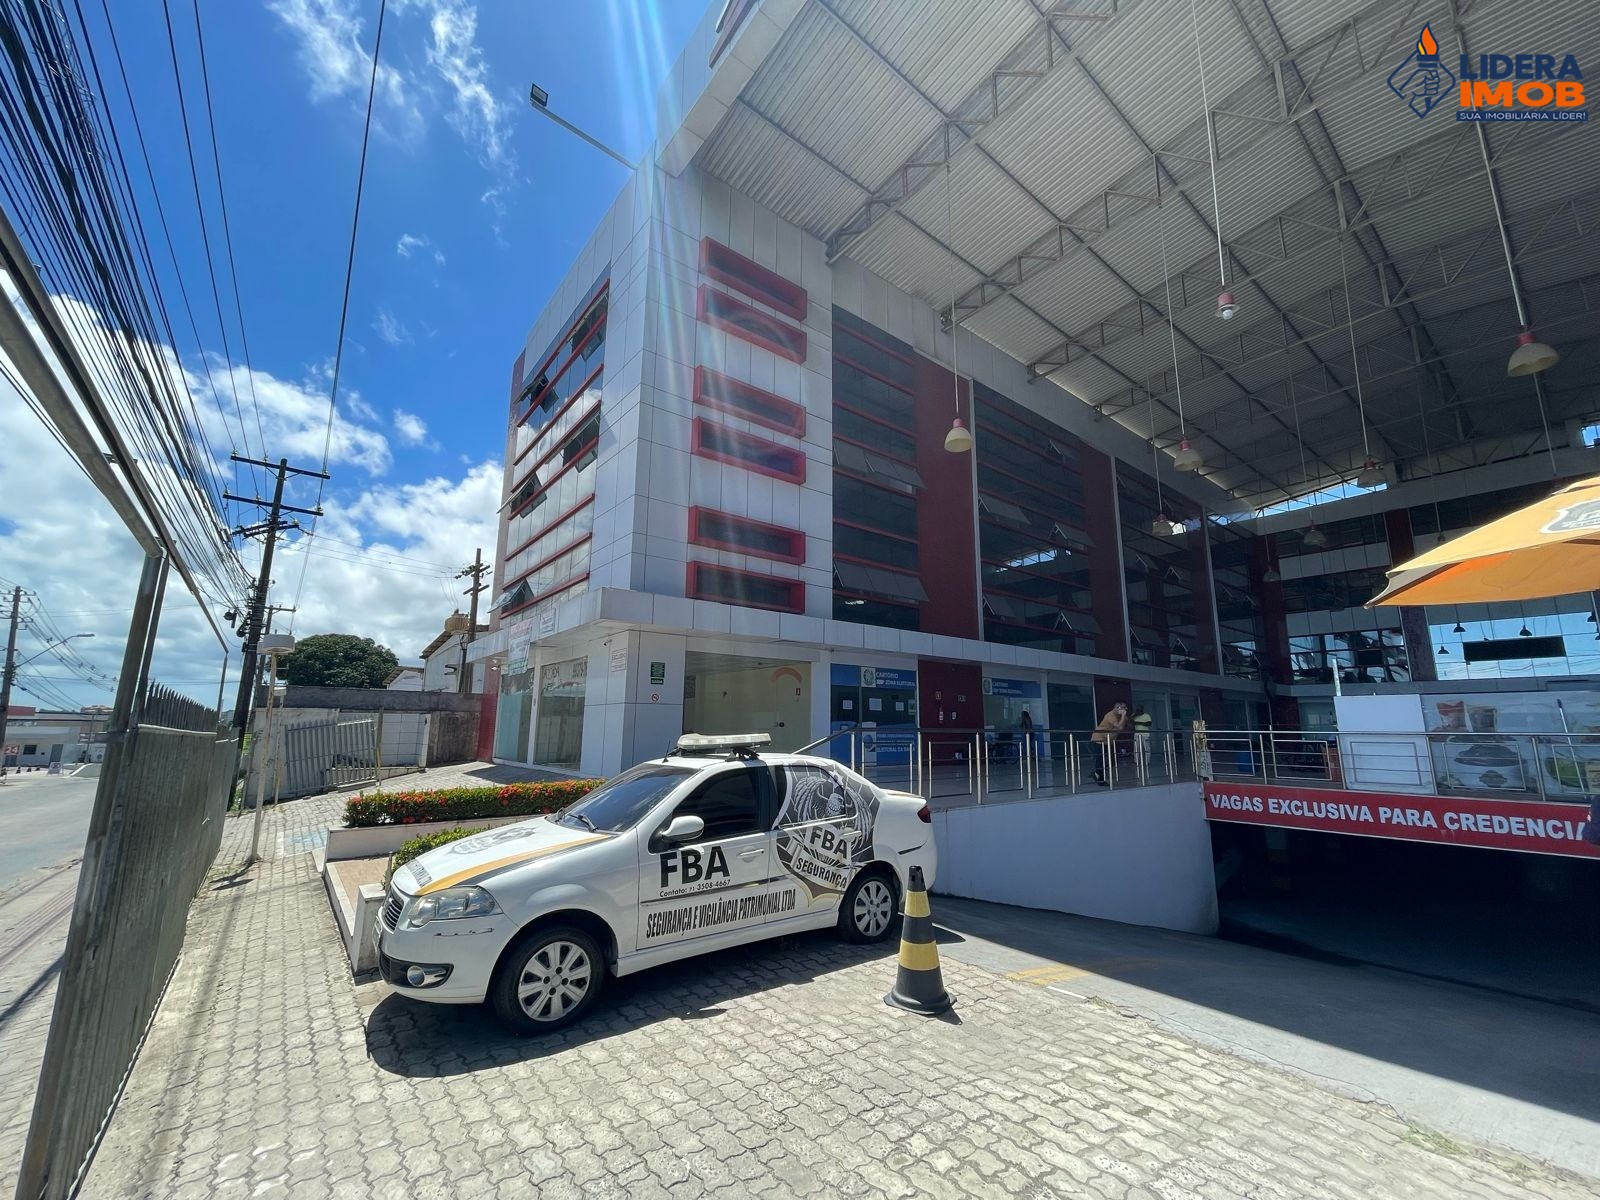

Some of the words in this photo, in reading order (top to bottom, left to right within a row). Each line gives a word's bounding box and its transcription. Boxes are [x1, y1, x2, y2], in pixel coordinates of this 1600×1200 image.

[1209, 793, 1264, 812] VAGAS
[1268, 798, 1375, 823] EXCLUSIVA
[1378, 807, 1438, 829] PARA
[809, 825, 848, 859] FBA
[659, 845, 731, 888] FBA
[796, 857, 848, 889] SEGURANÇA
[659, 888, 688, 898] Contato:
[646, 904, 692, 938] SEGURANÇA
[693, 903, 698, 928] E
[698, 897, 738, 928] VIGILÂNCIA
[738, 894, 781, 920] PATRIMONIAL
[781, 889, 796, 911] LTDA
